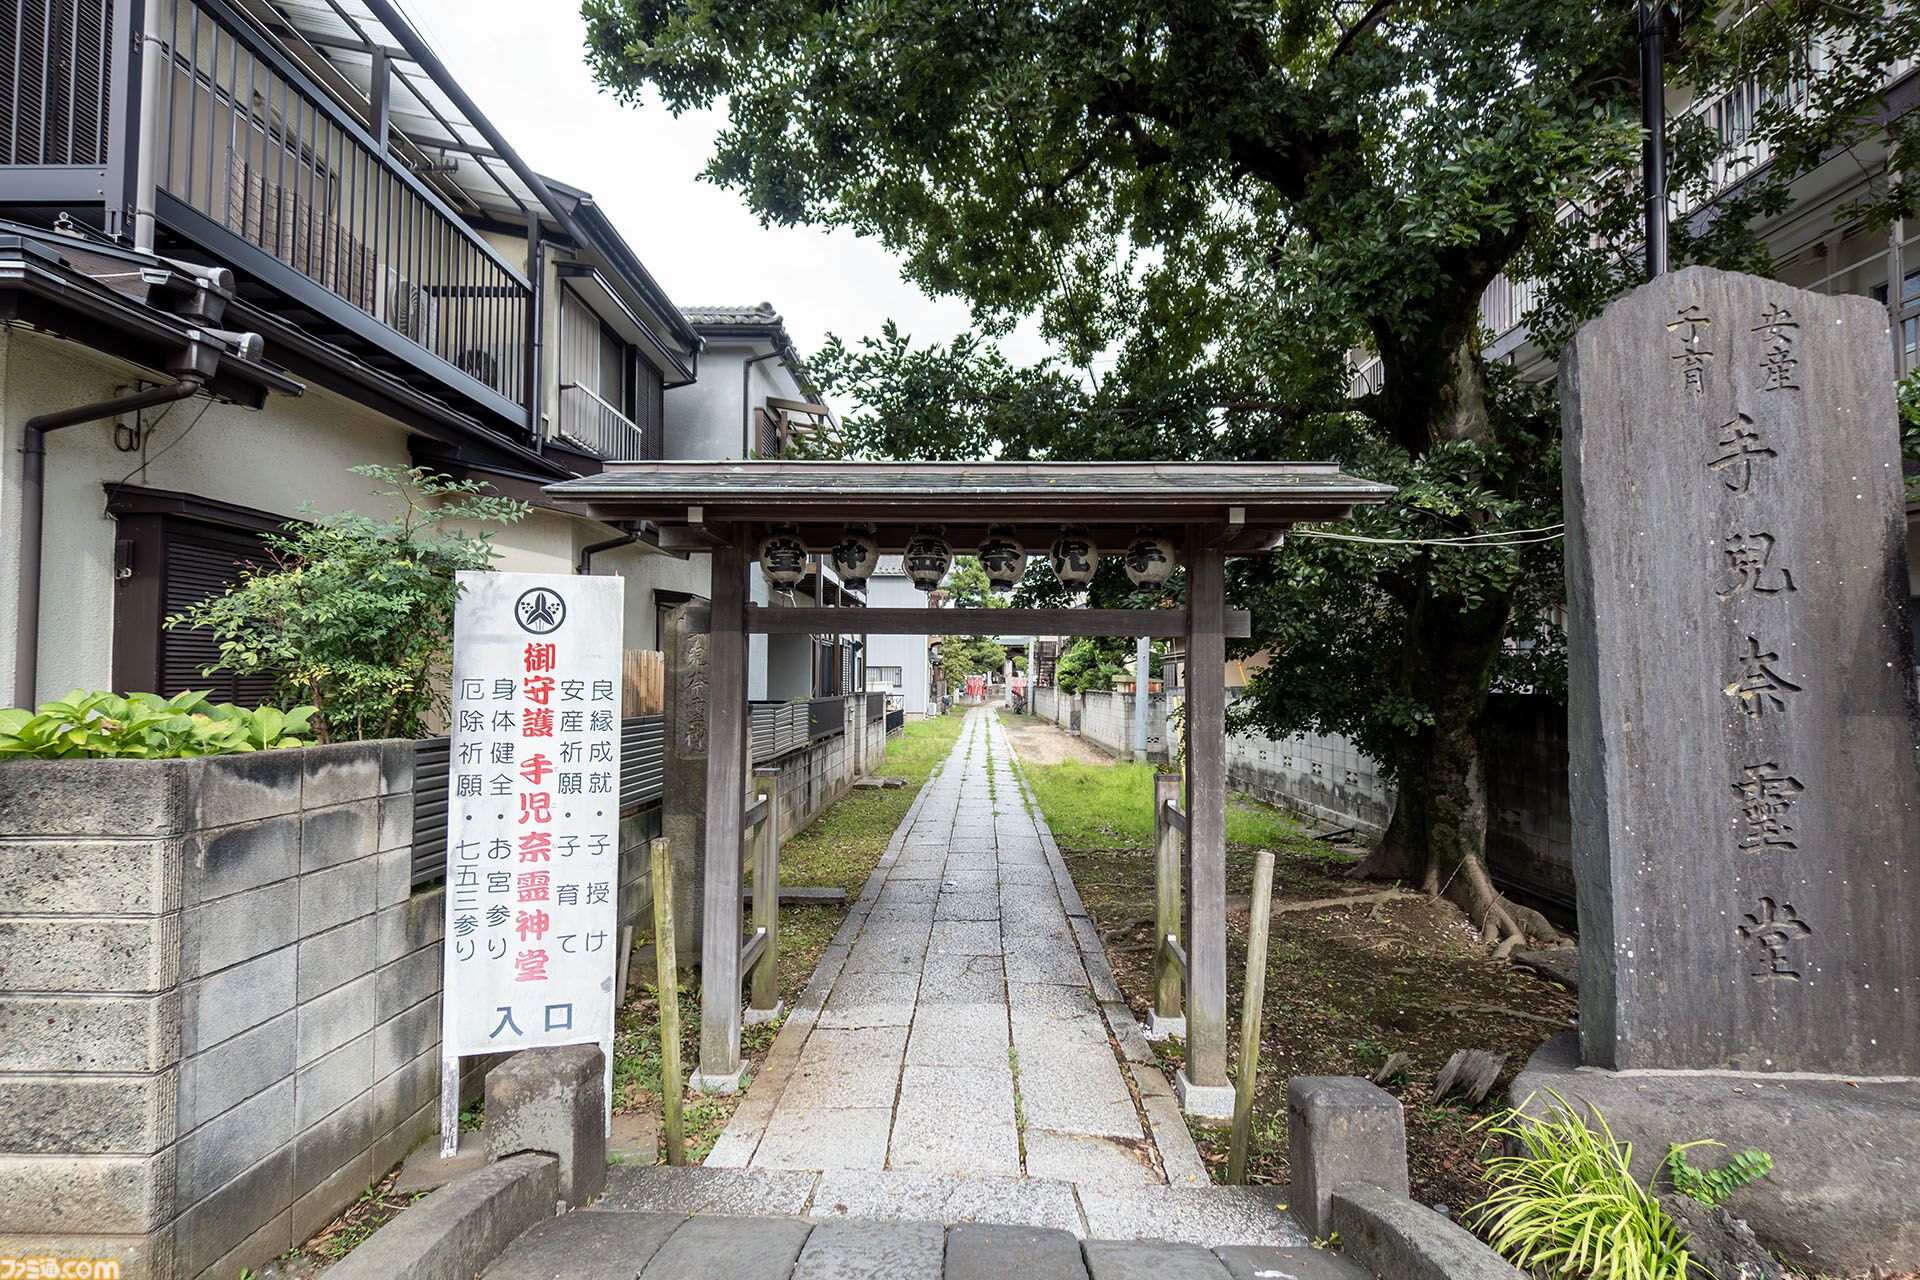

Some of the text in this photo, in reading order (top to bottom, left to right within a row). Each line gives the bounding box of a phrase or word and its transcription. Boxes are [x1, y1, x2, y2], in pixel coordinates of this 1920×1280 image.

[1665, 305, 1714, 395] 子育
[1750, 302, 1800, 392] 安産
[489, 1003, 573, 1039] 入口
